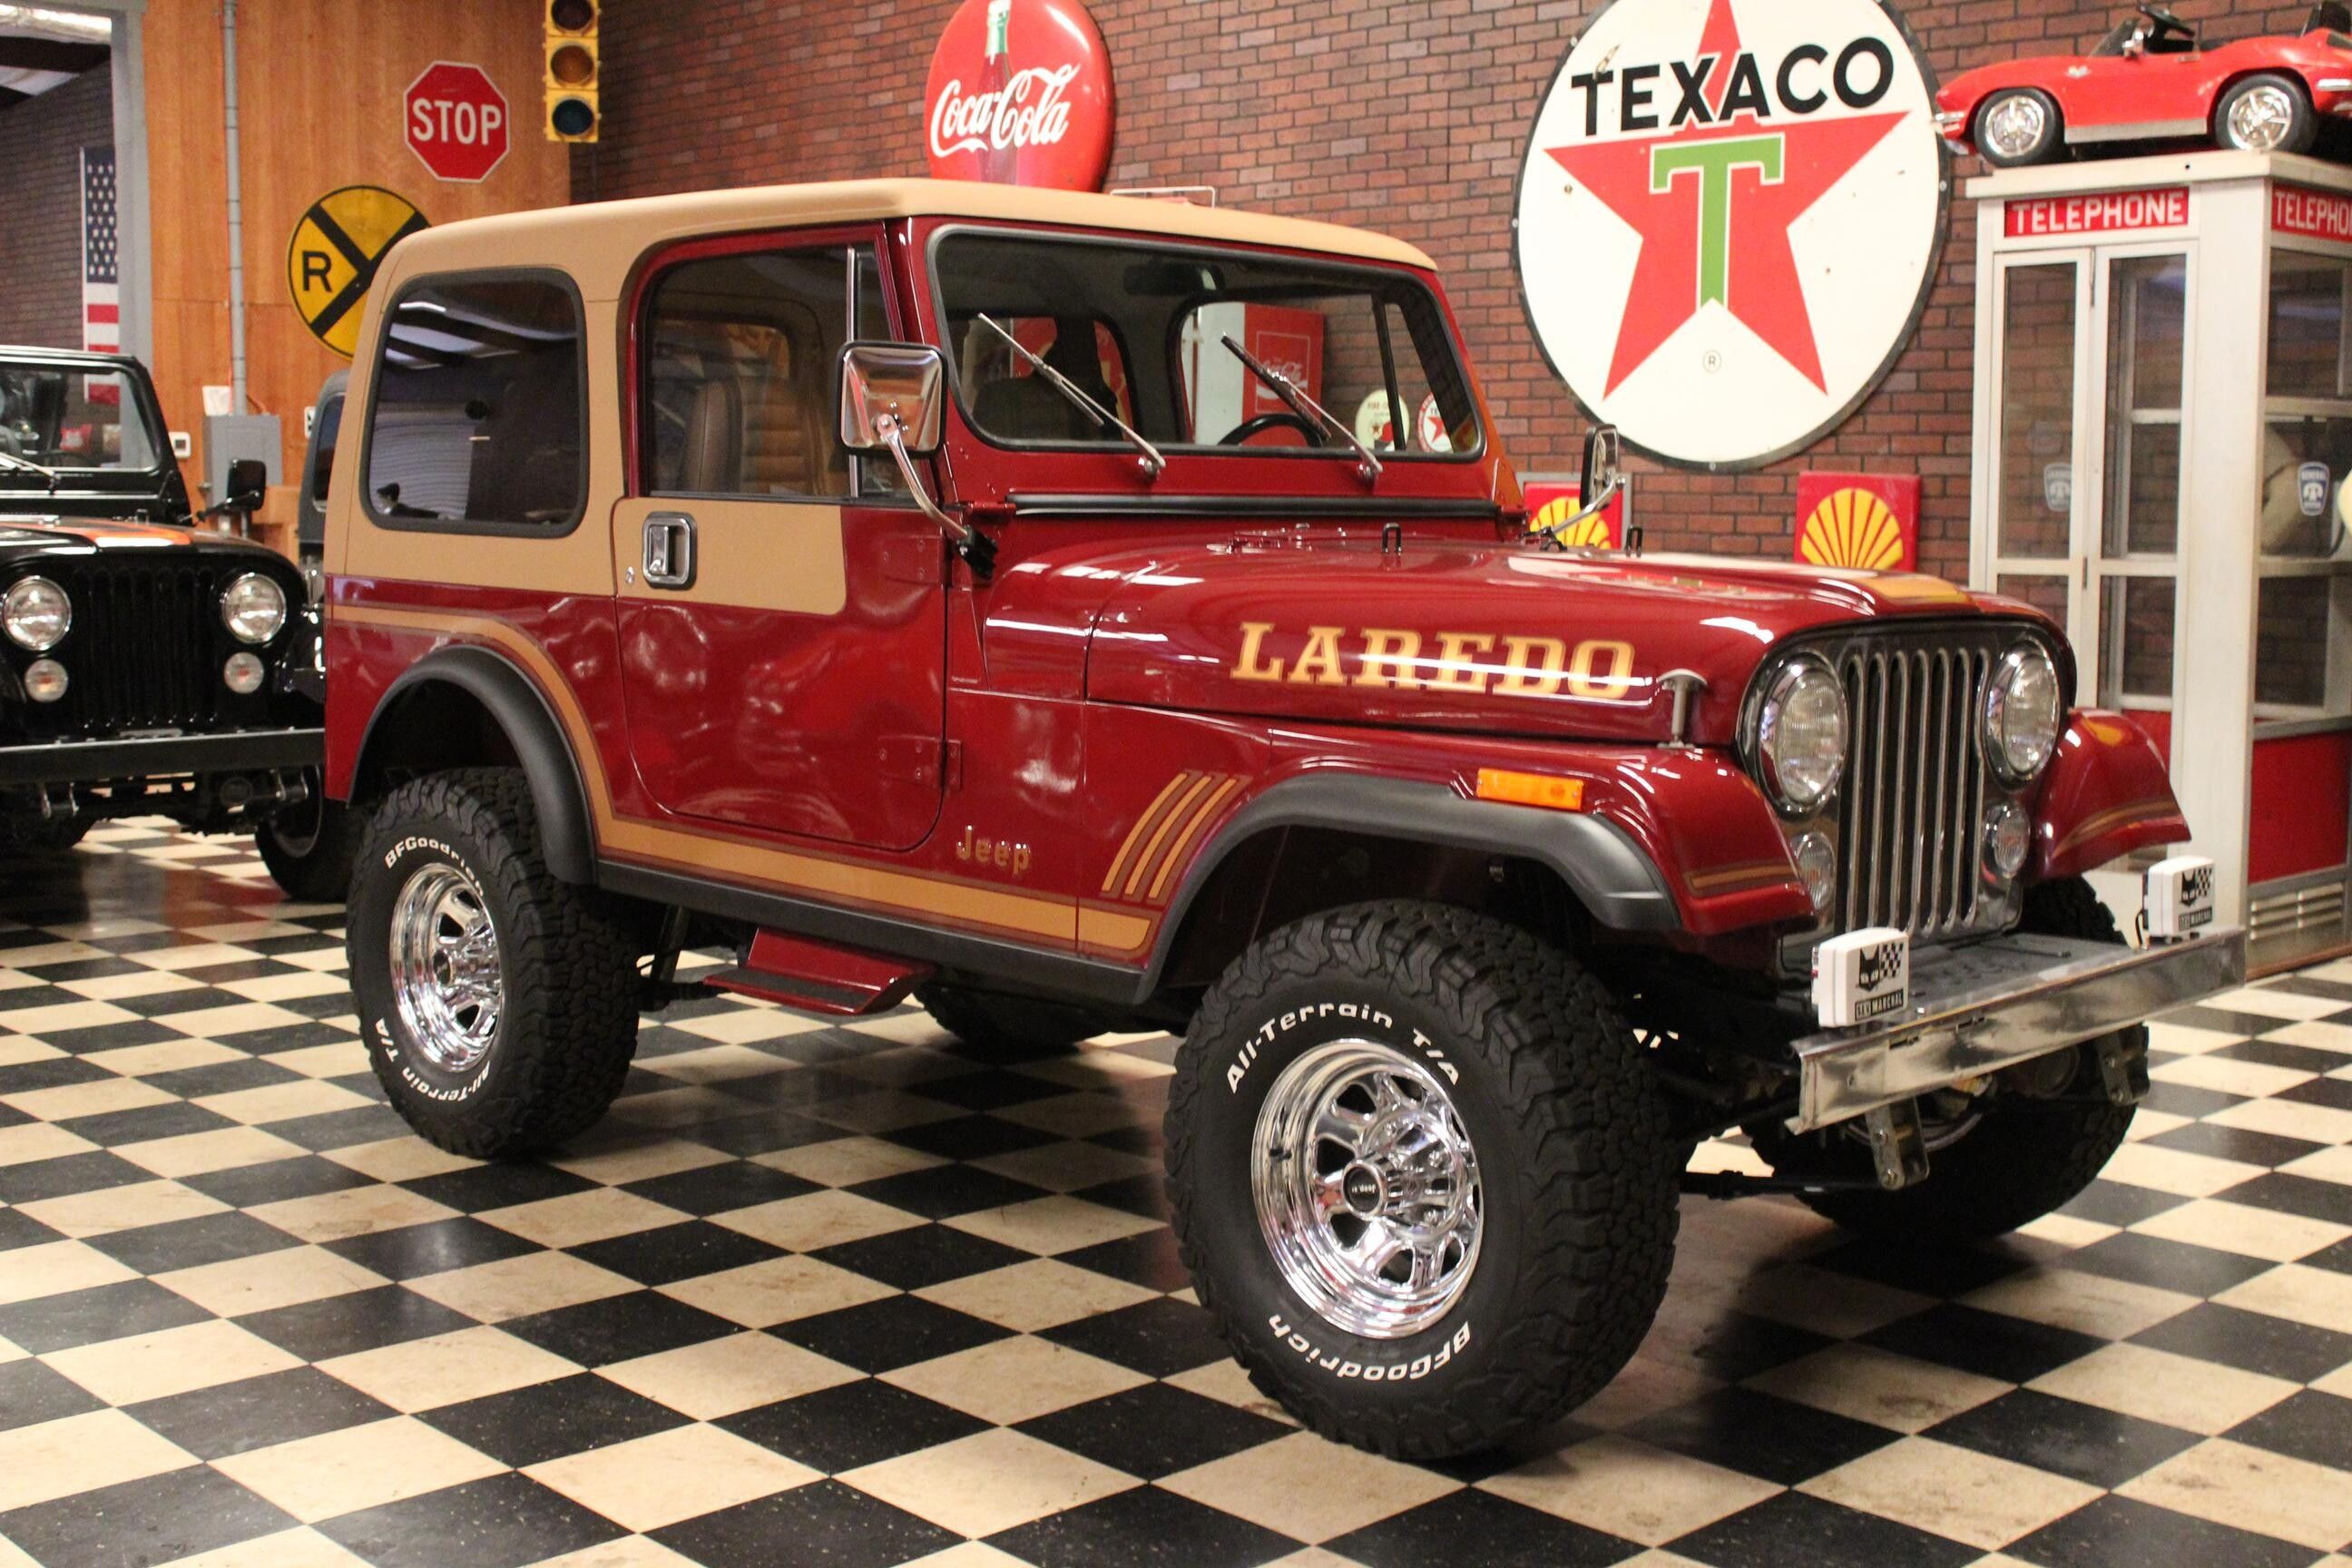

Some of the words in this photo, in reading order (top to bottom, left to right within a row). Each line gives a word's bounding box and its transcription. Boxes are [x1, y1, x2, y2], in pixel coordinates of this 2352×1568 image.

[930, 64, 1081, 158] Coca-Cola
[1571, 36, 1895, 137] TEXACO
[412, 97, 502, 145] STOP
[1651, 134, 1783, 309] T
[2012, 191, 2184, 234] TELEPHONE
[2275, 191, 2352, 235] TELEPHO
[302, 250, 332, 292] R
[1230, 621, 1635, 700] LAREDO
[384, 836, 484, 897] BFGoodrich
[956, 825, 1031, 874] Jeep
[375, 1018, 399, 1063] T/A
[1226, 1002, 1394, 1094] All-Terrain
[1413, 1027, 1460, 1086] T/A
[402, 1060, 490, 1102] All-Terrain
[1269, 1314, 1471, 1382] BFGoodrich
